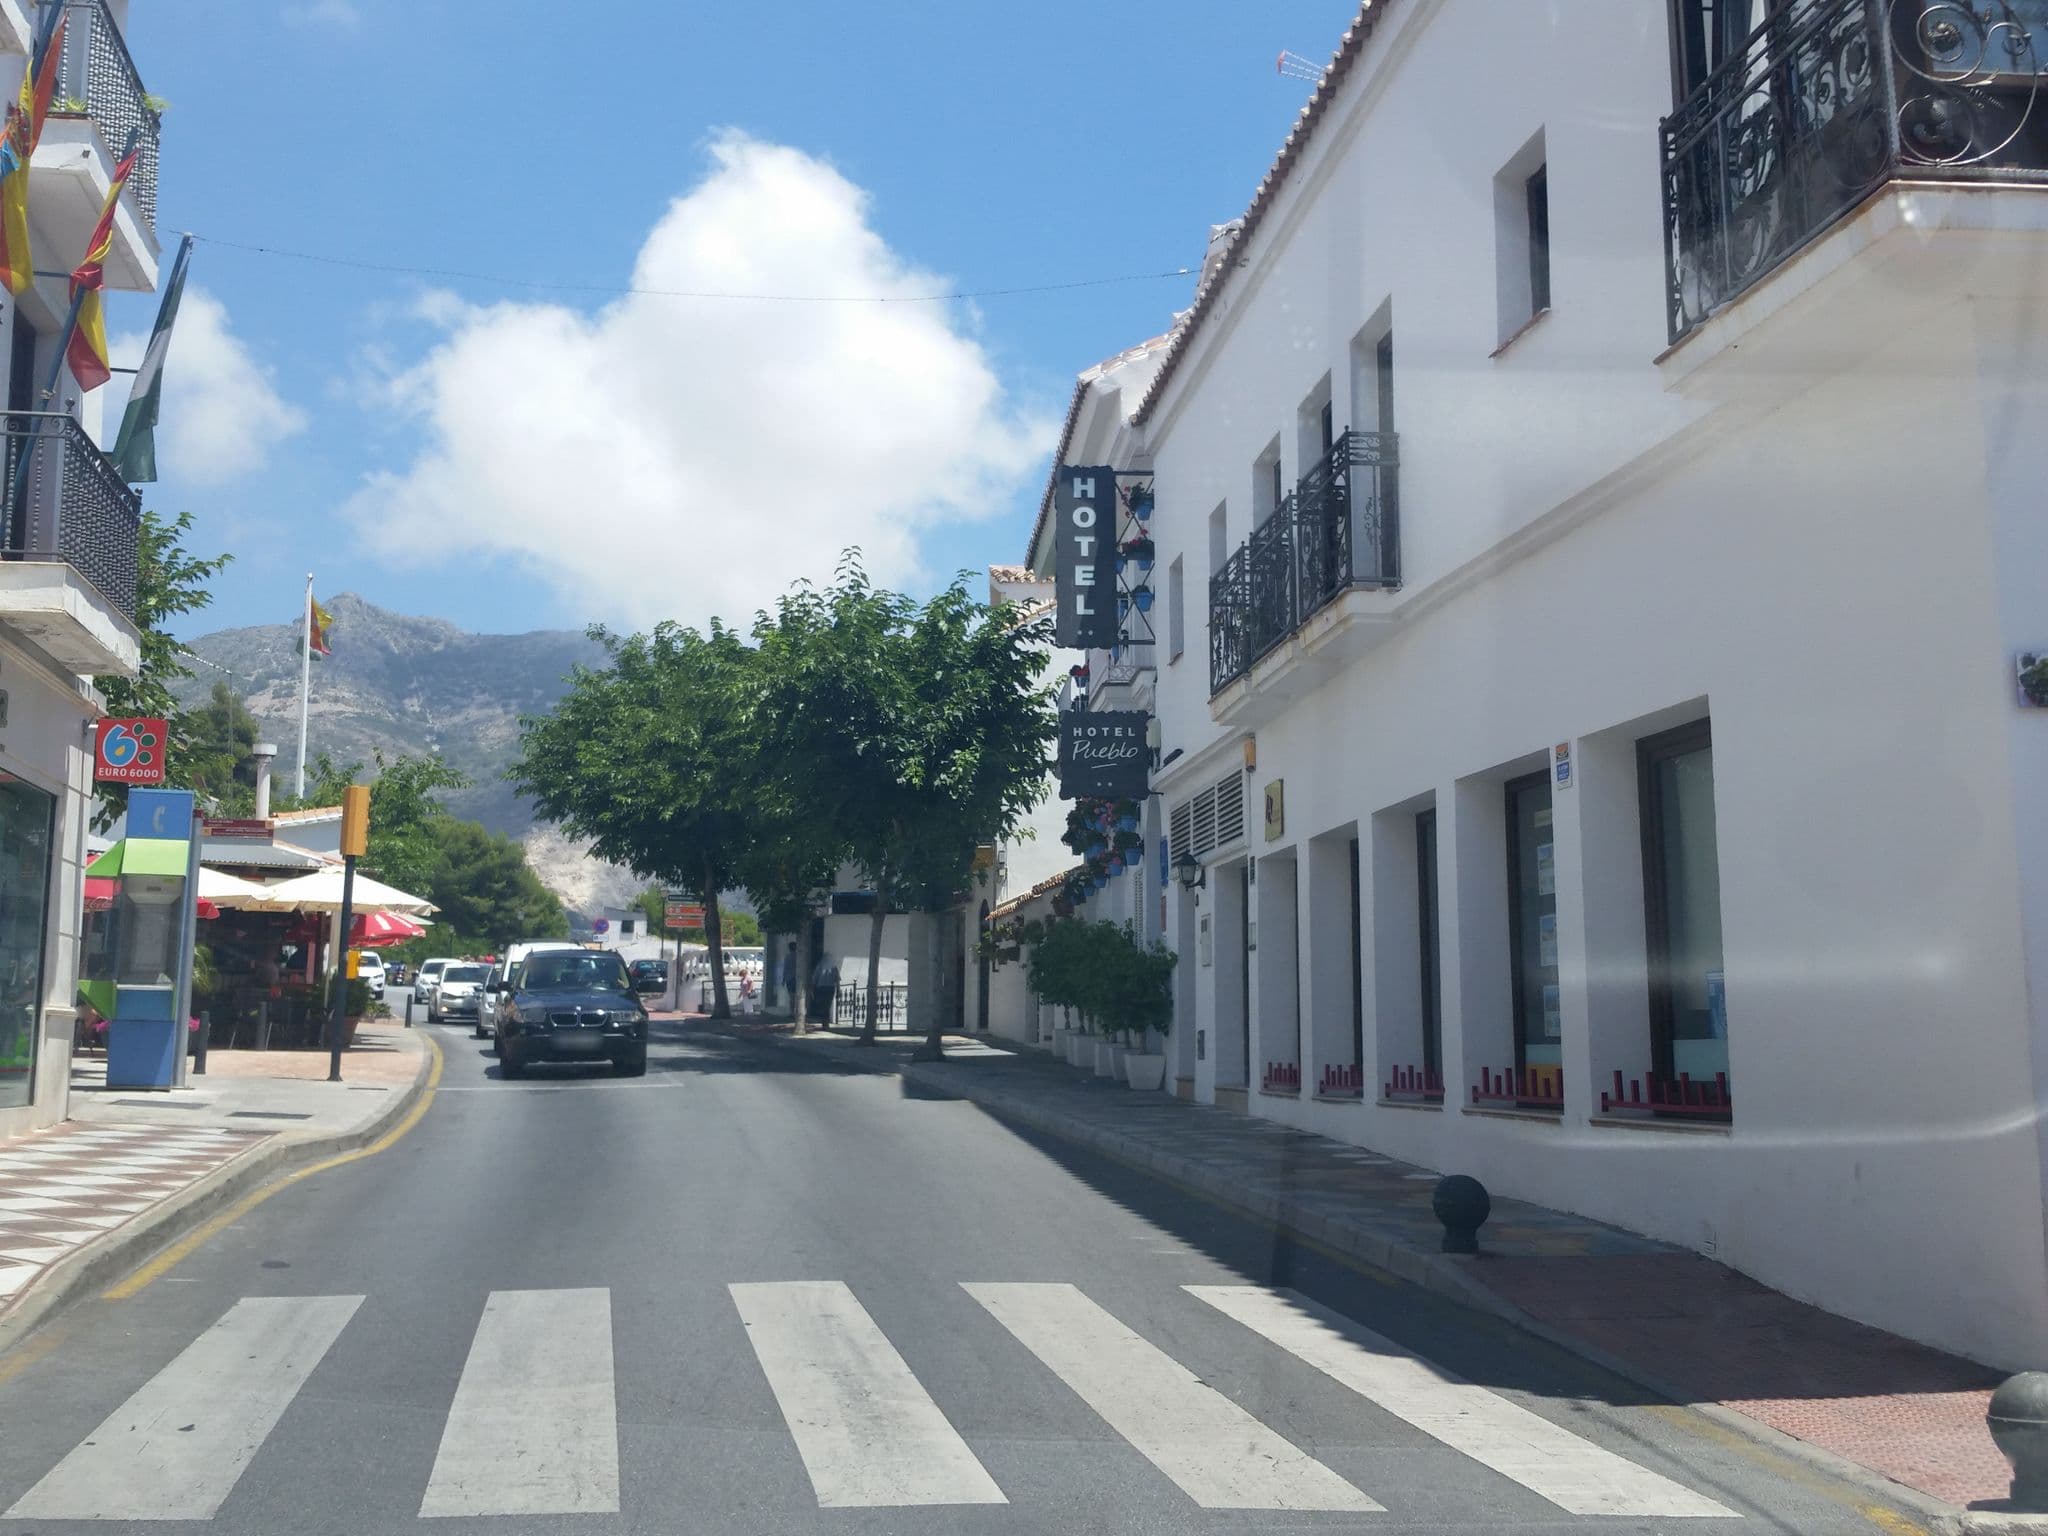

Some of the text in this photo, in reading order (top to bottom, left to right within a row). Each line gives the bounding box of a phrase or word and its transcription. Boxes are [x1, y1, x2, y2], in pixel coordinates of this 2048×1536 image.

[1072, 477, 1096, 615] HOTEL
[1073, 727, 1136, 737] HOTEL
[1072, 739, 1138, 761] Pueblo
[98, 768, 159, 778] EURO 6000
